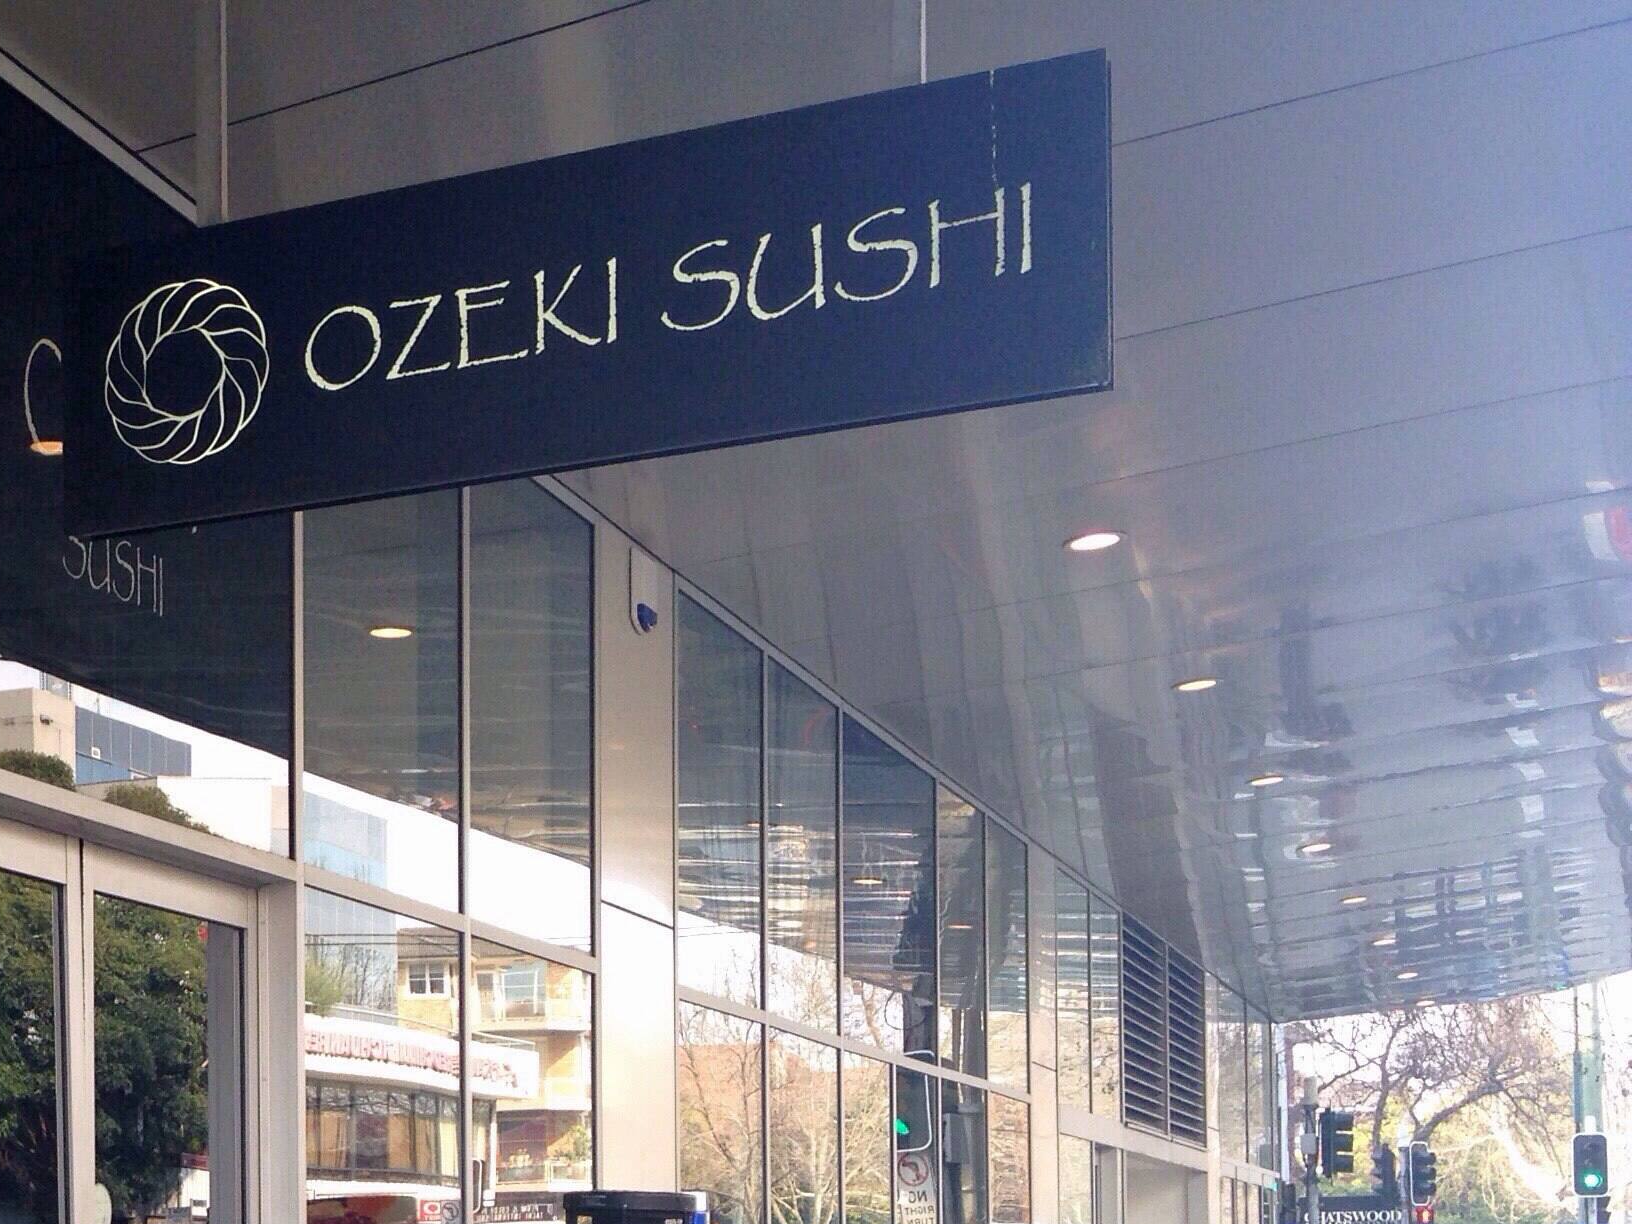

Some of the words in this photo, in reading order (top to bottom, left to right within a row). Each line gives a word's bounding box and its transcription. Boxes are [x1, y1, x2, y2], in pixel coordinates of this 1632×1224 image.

[304, 257, 618, 391] OZEKI
[660, 181, 1032, 331] SUSHI
[63, 535, 164, 617] SUSHI
